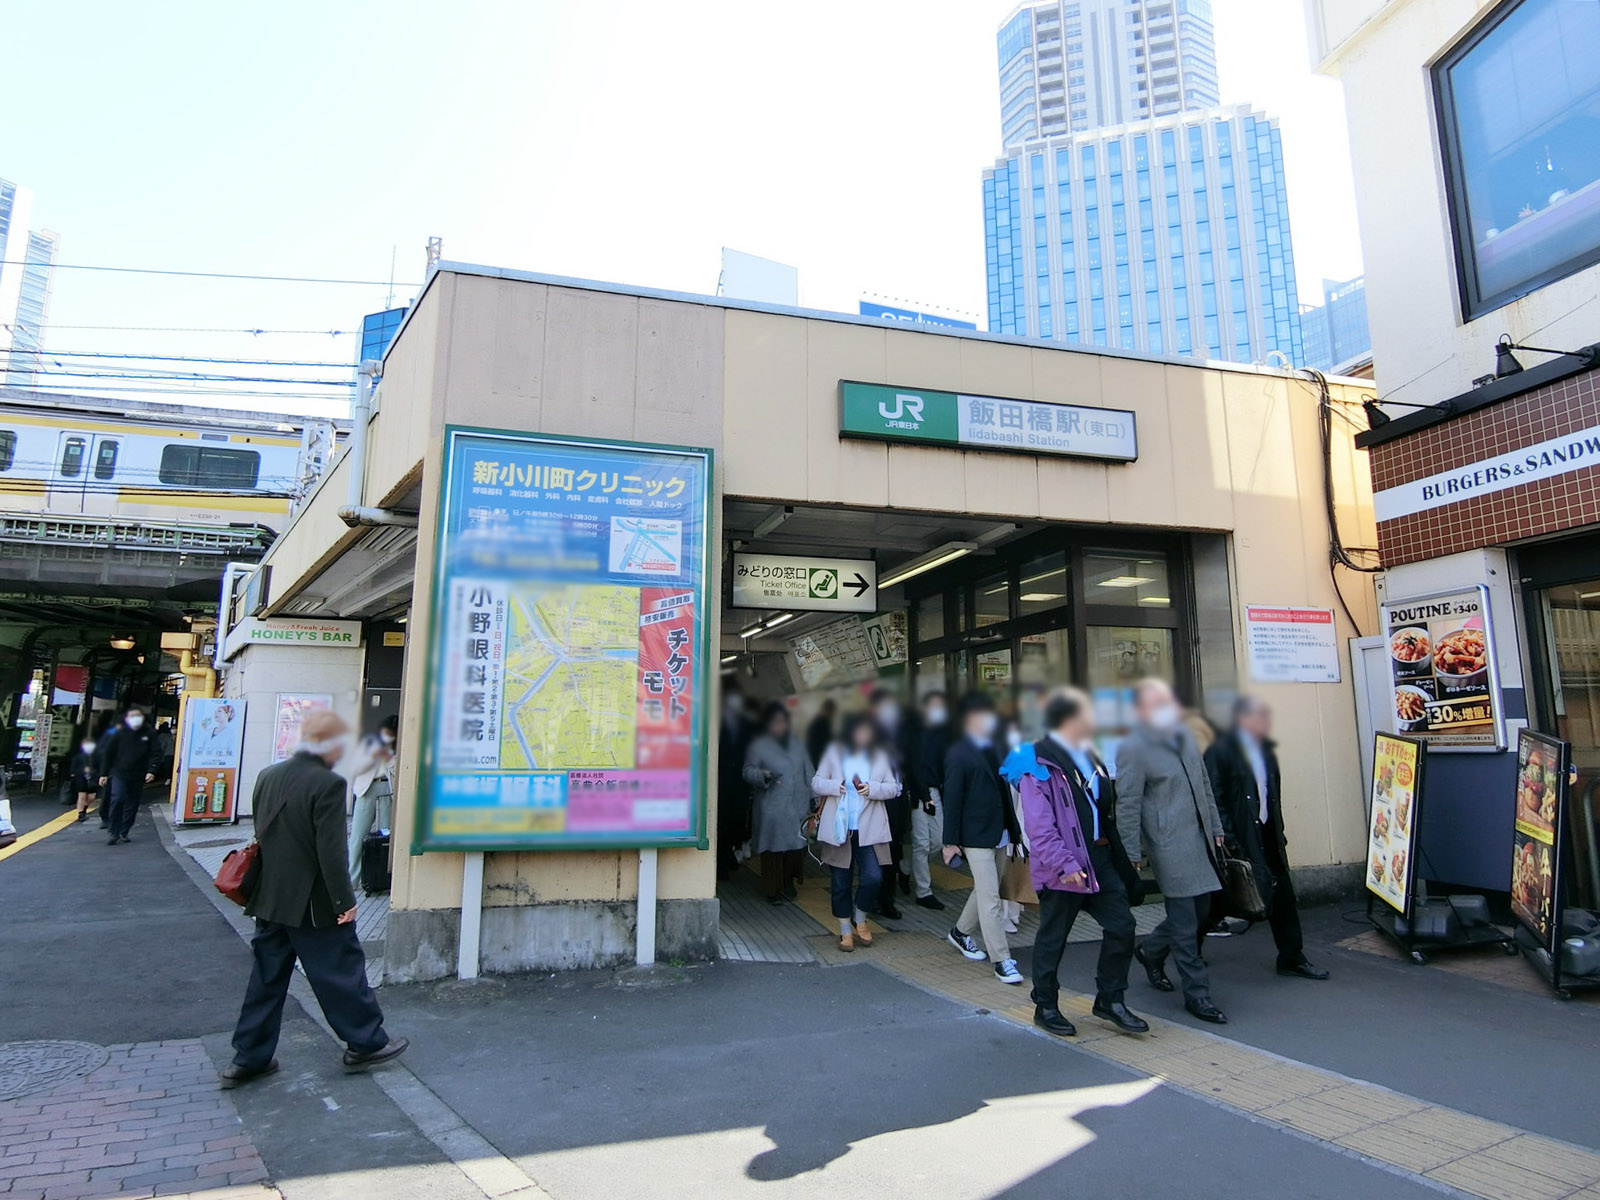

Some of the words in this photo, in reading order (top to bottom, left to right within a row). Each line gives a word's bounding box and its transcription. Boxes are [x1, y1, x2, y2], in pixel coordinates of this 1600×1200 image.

[878, 394, 924, 422] JR
[885, 420, 920, 431] JR東日本
[968, 427, 1024, 444] Iidabashi
[1028, 432, 1070, 448] Station
[472, 459, 686, 498] 新小川町クリニック
[737, 564, 807, 580] みどりの窓口
[760, 580, 783, 589] Ticket
[784, 580, 807, 590] Office
[1390, 602, 1451, 623] POUTINE
[1453, 603, 1478, 614] ¥340
[251, 629, 317, 641] HONEY'S
[322, 632, 352, 642] BAR
[319, 624, 340, 632] Juice
[460, 585, 493, 742] 小野眼科医院
[667, 628, 688, 721] チケット
